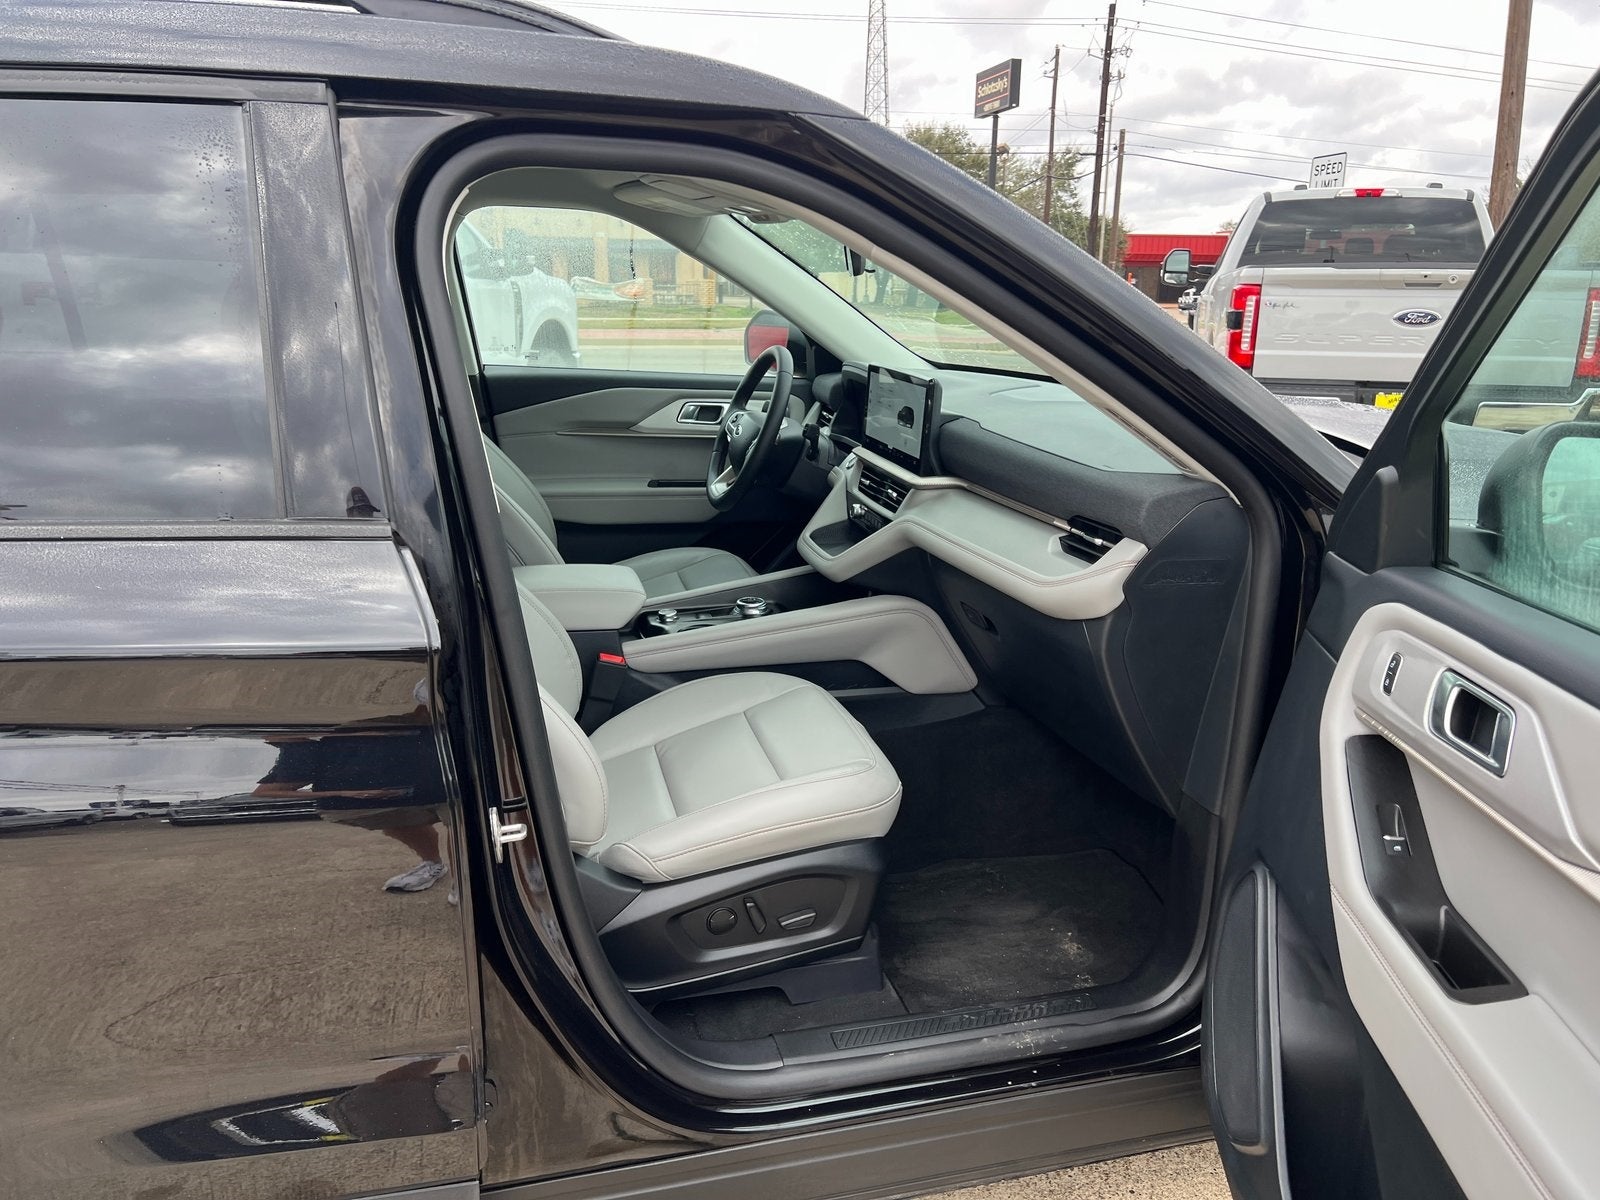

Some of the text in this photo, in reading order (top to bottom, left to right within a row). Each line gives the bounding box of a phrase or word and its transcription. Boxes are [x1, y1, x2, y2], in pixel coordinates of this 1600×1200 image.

[1314, 161, 1343, 176] SPEED
[1404, 312, 1431, 324] Ford
[1274, 332, 1426, 346] SUPER
